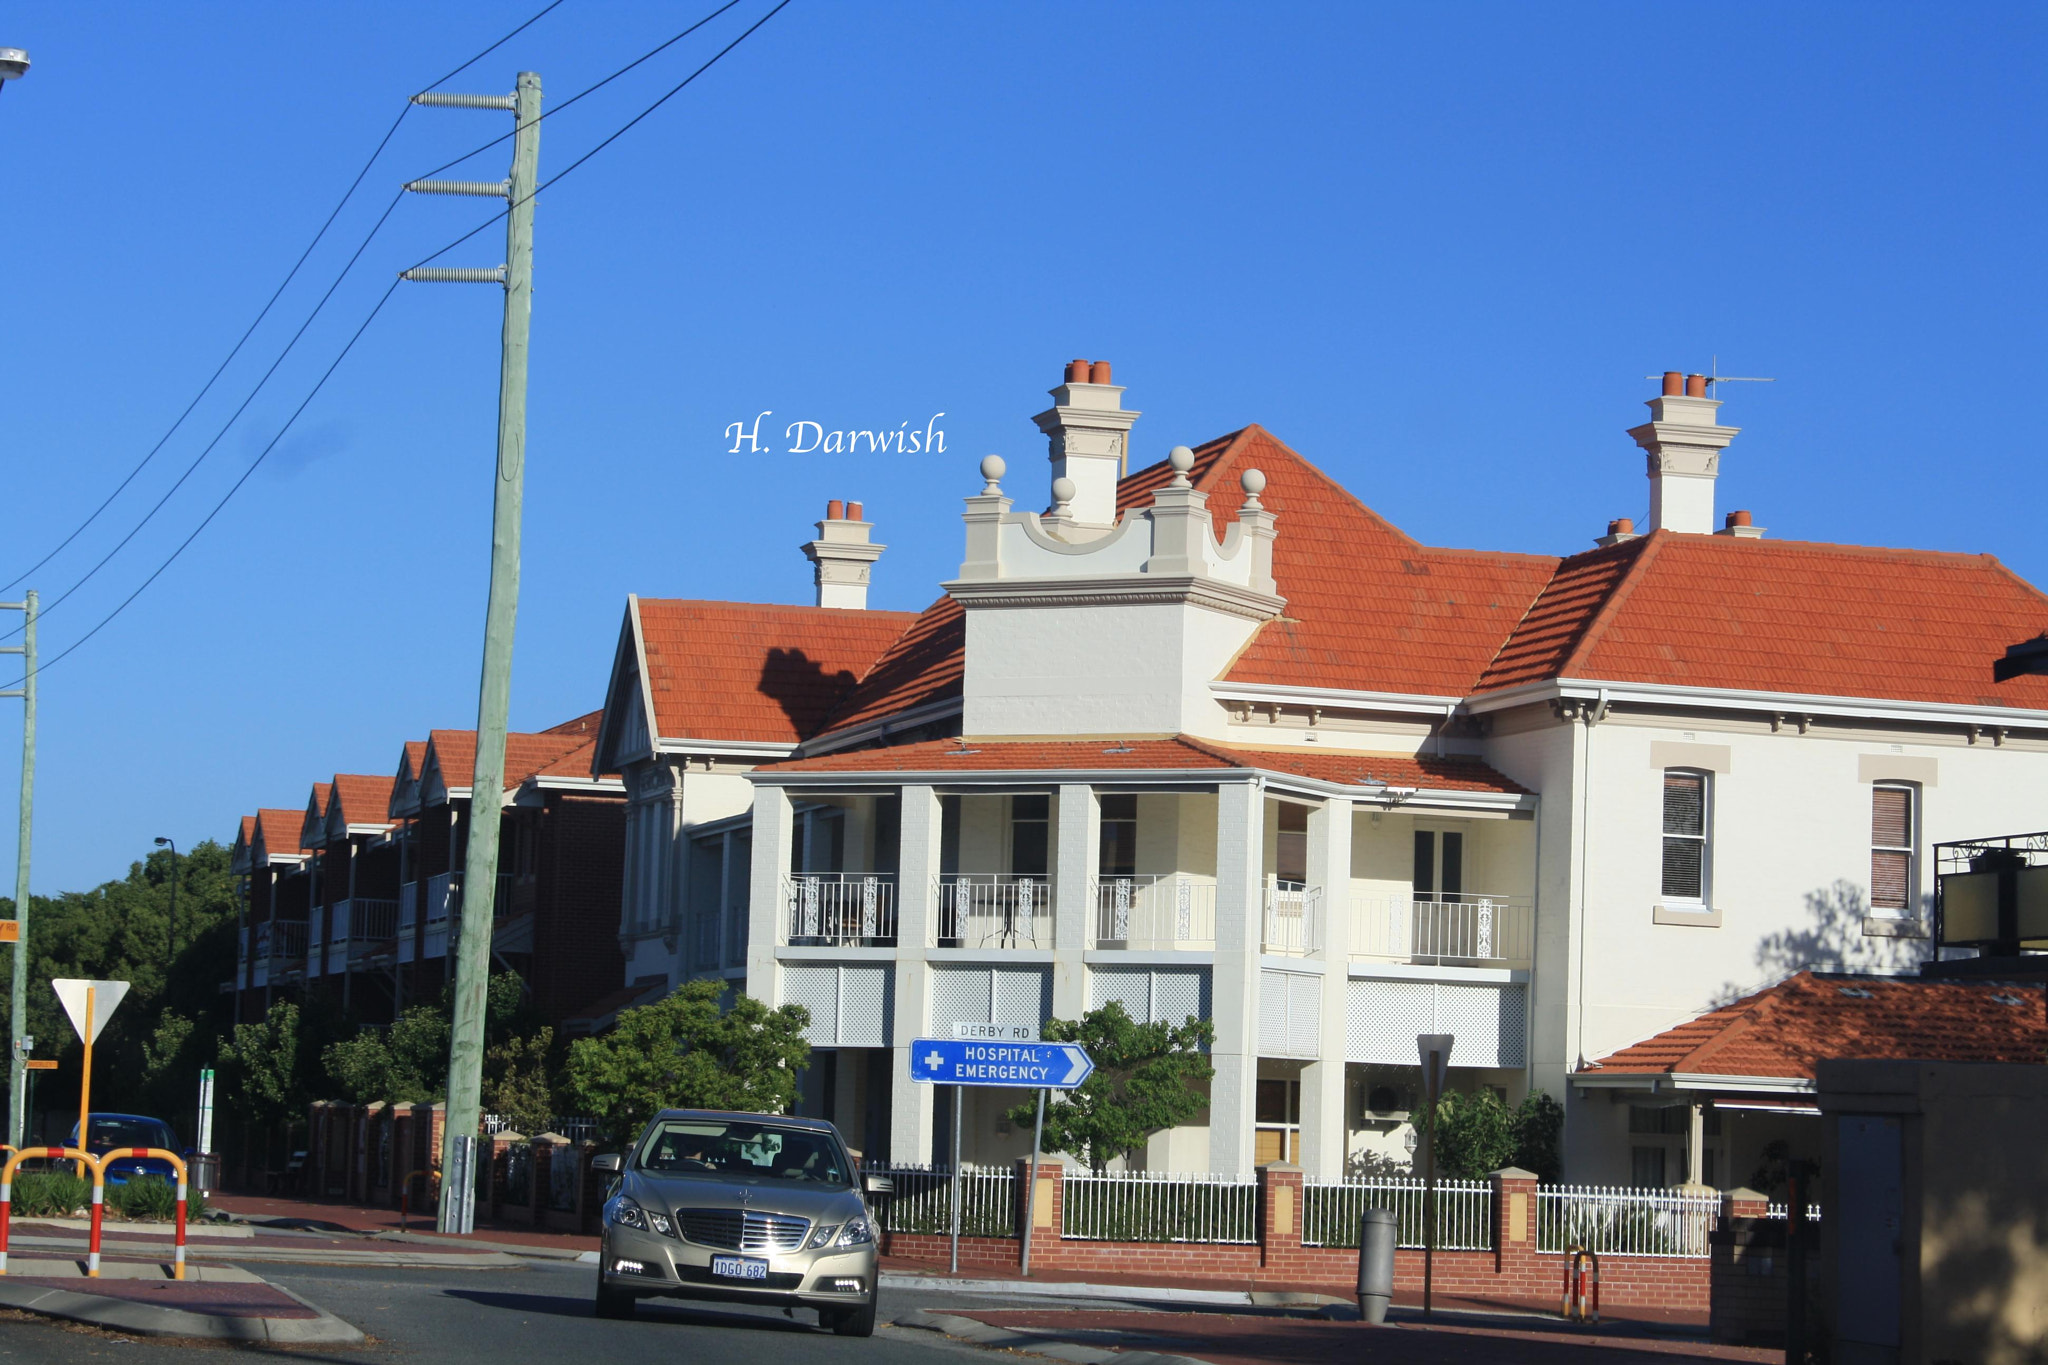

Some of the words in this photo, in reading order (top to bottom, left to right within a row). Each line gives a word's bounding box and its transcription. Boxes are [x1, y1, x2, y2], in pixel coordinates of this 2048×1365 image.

[961, 1025, 1005, 1037] DERBY
[1012, 1027, 1030, 1038] RD
[965, 1046, 1040, 1063] HOSPITAL
[955, 1063, 1049, 1080] EMERGENCY
